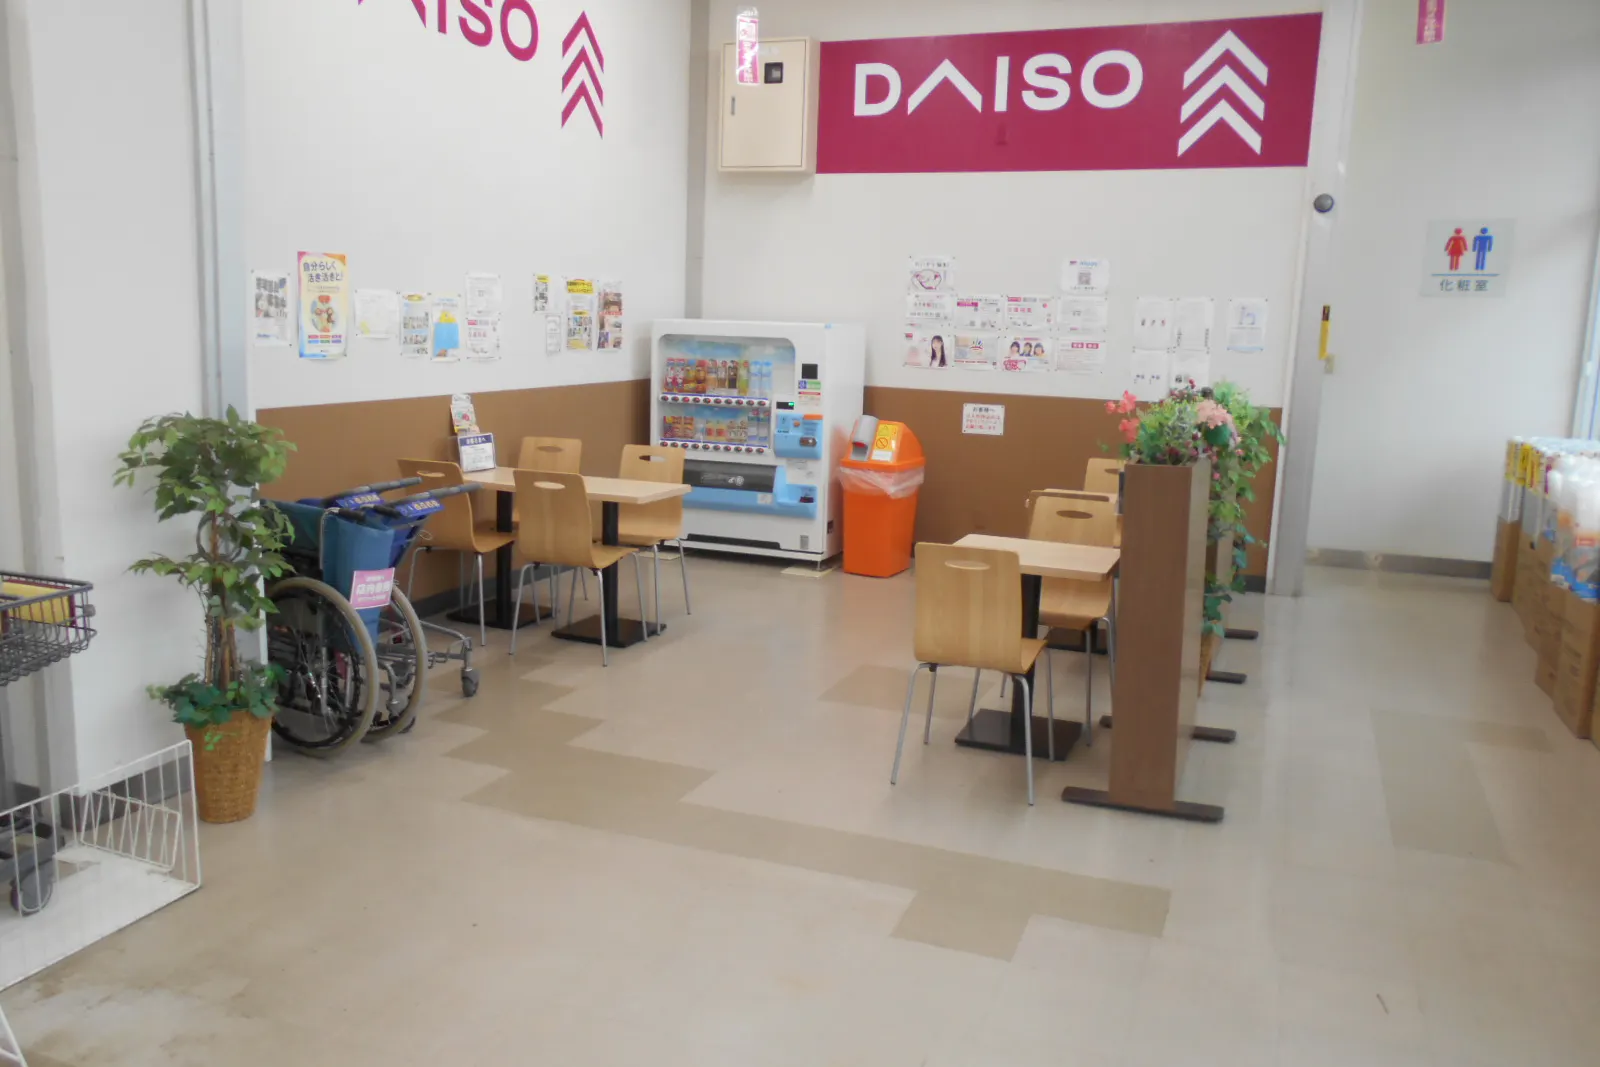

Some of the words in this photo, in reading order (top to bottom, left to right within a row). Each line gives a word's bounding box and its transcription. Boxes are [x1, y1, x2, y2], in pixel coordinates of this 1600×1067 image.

[853, 49, 1144, 117] DAISO
[303, 261, 337, 272] 自分らしく
[1439, 279, 1489, 292] 化粧室
